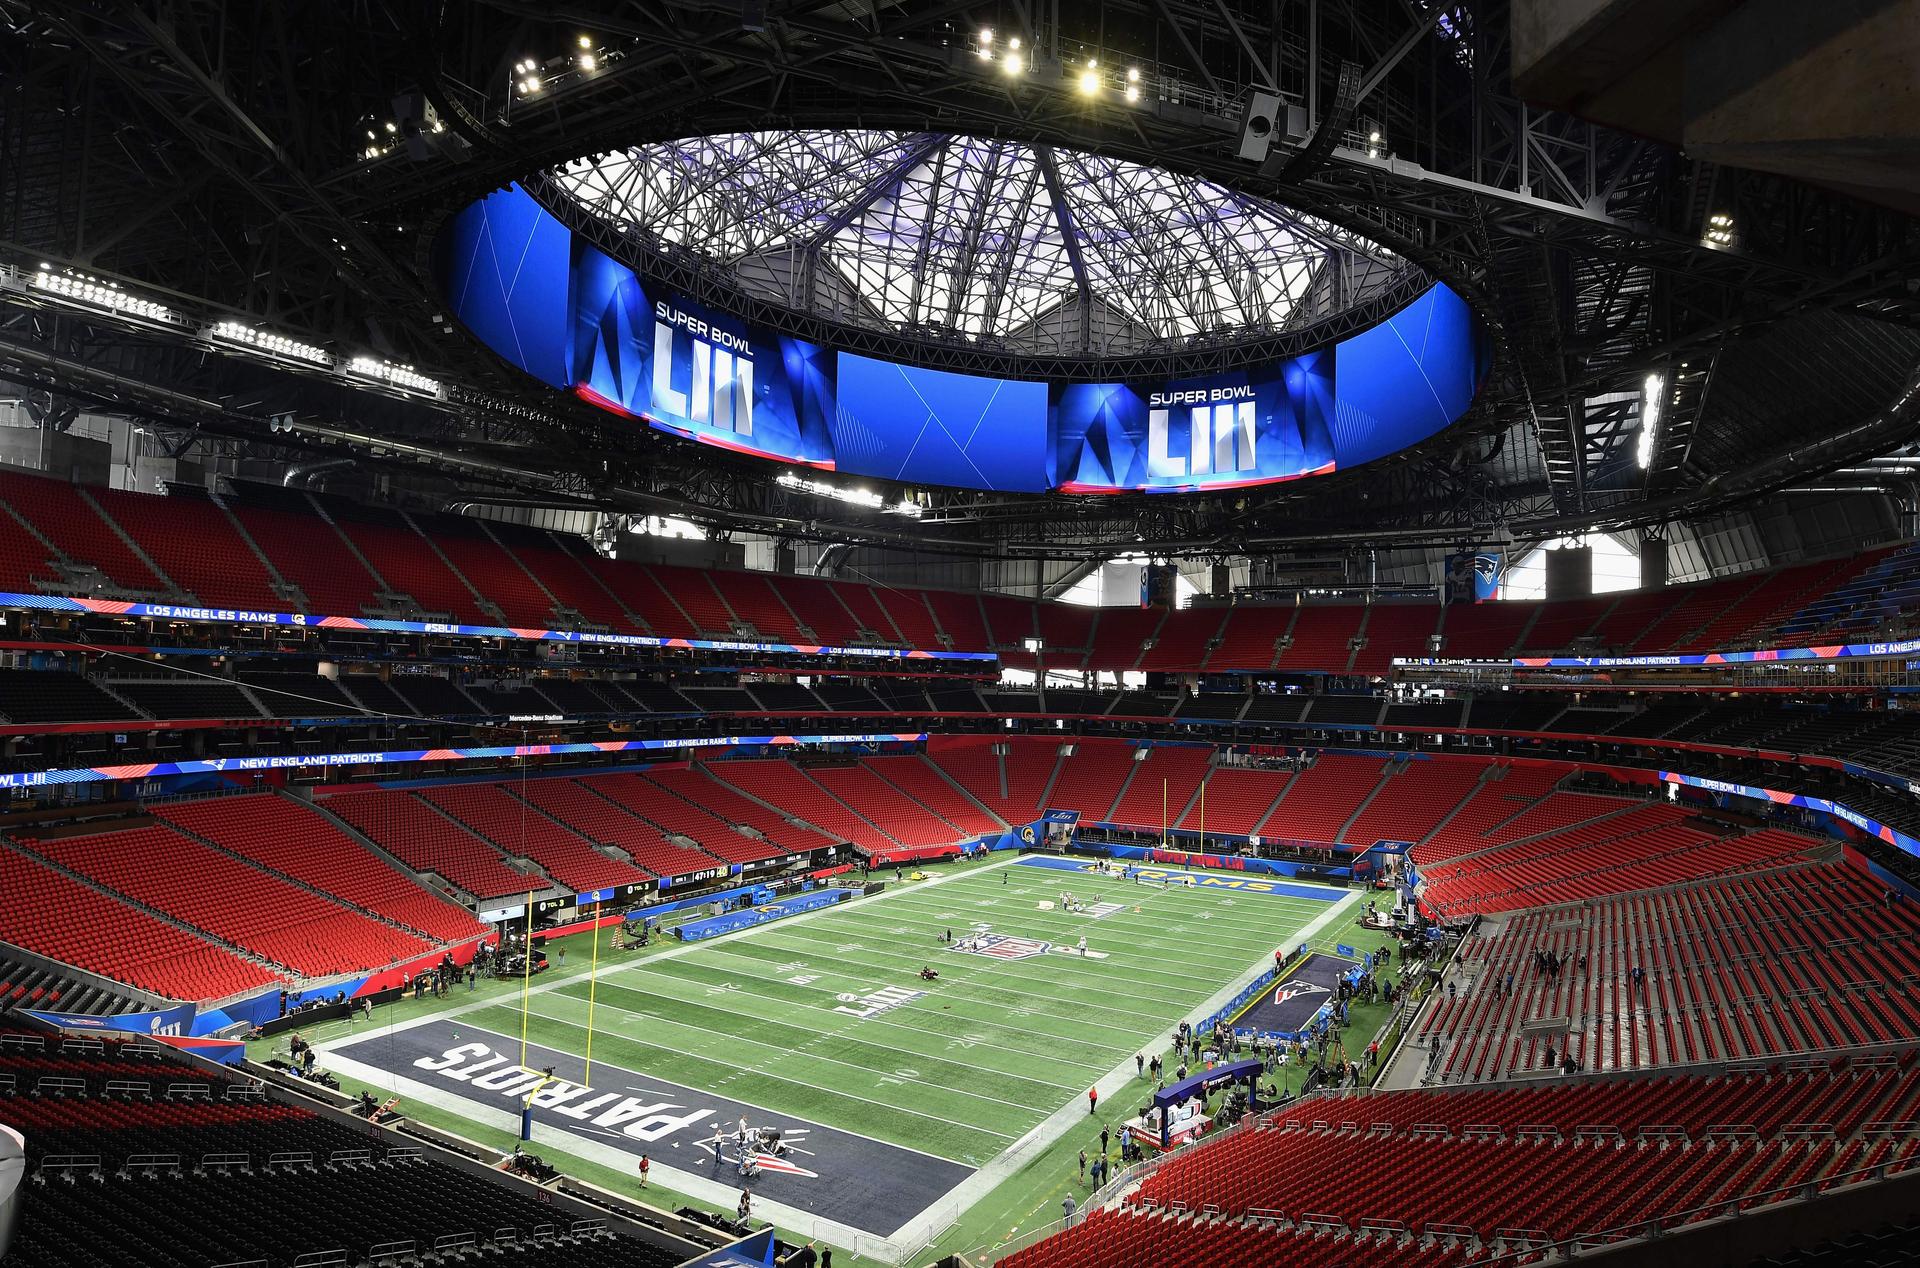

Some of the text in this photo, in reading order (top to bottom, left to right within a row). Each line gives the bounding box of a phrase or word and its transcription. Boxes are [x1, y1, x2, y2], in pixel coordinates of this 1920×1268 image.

[656, 301, 754, 356] SUPER BOWL
[651, 321, 754, 437] LIII
[1150, 385, 1256, 405] SUPER BOWL
[1148, 401, 1256, 478] LIII
[146, 605, 277, 623] LOS ANGELES RAMS
[580, 633, 660, 645] NEW ENGLAND PATRIOTS
[843, 647, 872, 655] ANGELES
[1870, 643, 1887, 654] LOS
[1616, 657, 1646, 665] ENGLAND
[1647, 656, 1680, 664] PATRIOTS
[663, 740, 677, 748] LOS
[678, 739, 708, 747] ANGELES
[240, 753, 383, 768] NEW ENGLAND PATRIOTS
[24, 772, 46, 785] LIII
[1701, 779, 1719, 790] SUPER
[1720, 782, 1737, 793] BOWL
[695, 869, 716, 881] 47:19
[1136, 871, 1276, 891] RAMS
[627, 885, 633, 895] 0
[540, 902, 546, 911] 0
[413, 1043, 717, 1142] PATRIOTS
[539, 1191, 550, 1203] 136
